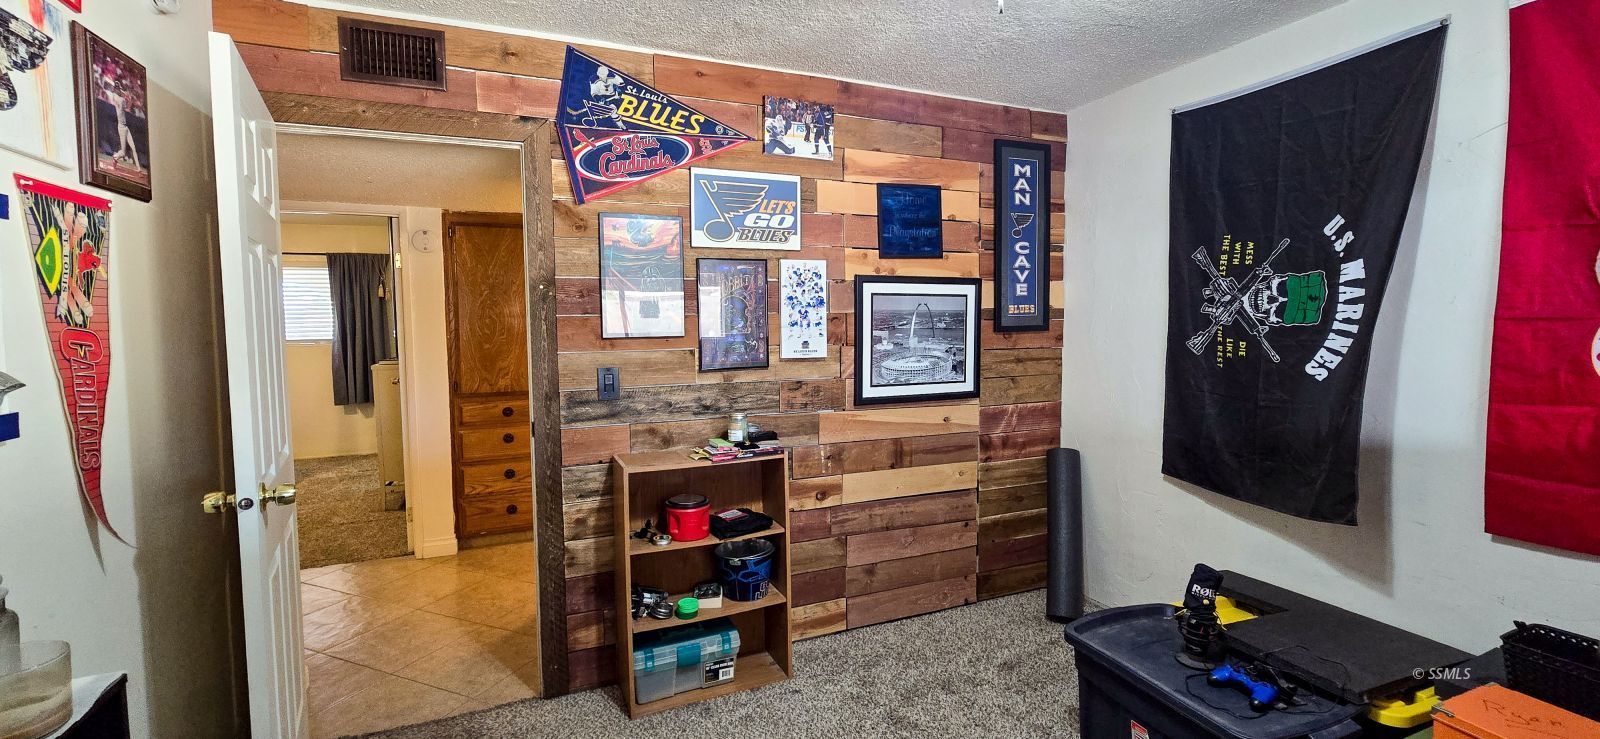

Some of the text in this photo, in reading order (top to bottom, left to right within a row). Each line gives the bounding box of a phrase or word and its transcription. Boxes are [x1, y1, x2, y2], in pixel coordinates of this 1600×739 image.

[625, 85, 668, 104] St. Louis
[617, 94, 705, 134] BLUES
[628, 134, 660, 155] Louis
[599, 149, 677, 179] Cardinals
[1013, 163, 1032, 206] MAN
[759, 199, 796, 215] LET'S
[743, 213, 795, 229] GO
[736, 227, 795, 244] BLUES
[1323, 214, 1355, 257] U.S.
[1219, 234, 1231, 276] THE BEST
[1232, 242, 1242, 265] WITH
[1245, 241, 1254, 265] MESS
[1013, 241, 1031, 297] CAVE
[1008, 304, 1035, 314] BLUES
[1304, 258, 1366, 382] MARINES
[1216, 326, 1224, 343] THE
[1226, 338, 1234, 358] LIKE
[1239, 341, 1247, 357] DIE
[60, 327, 104, 472] CARDINALS
